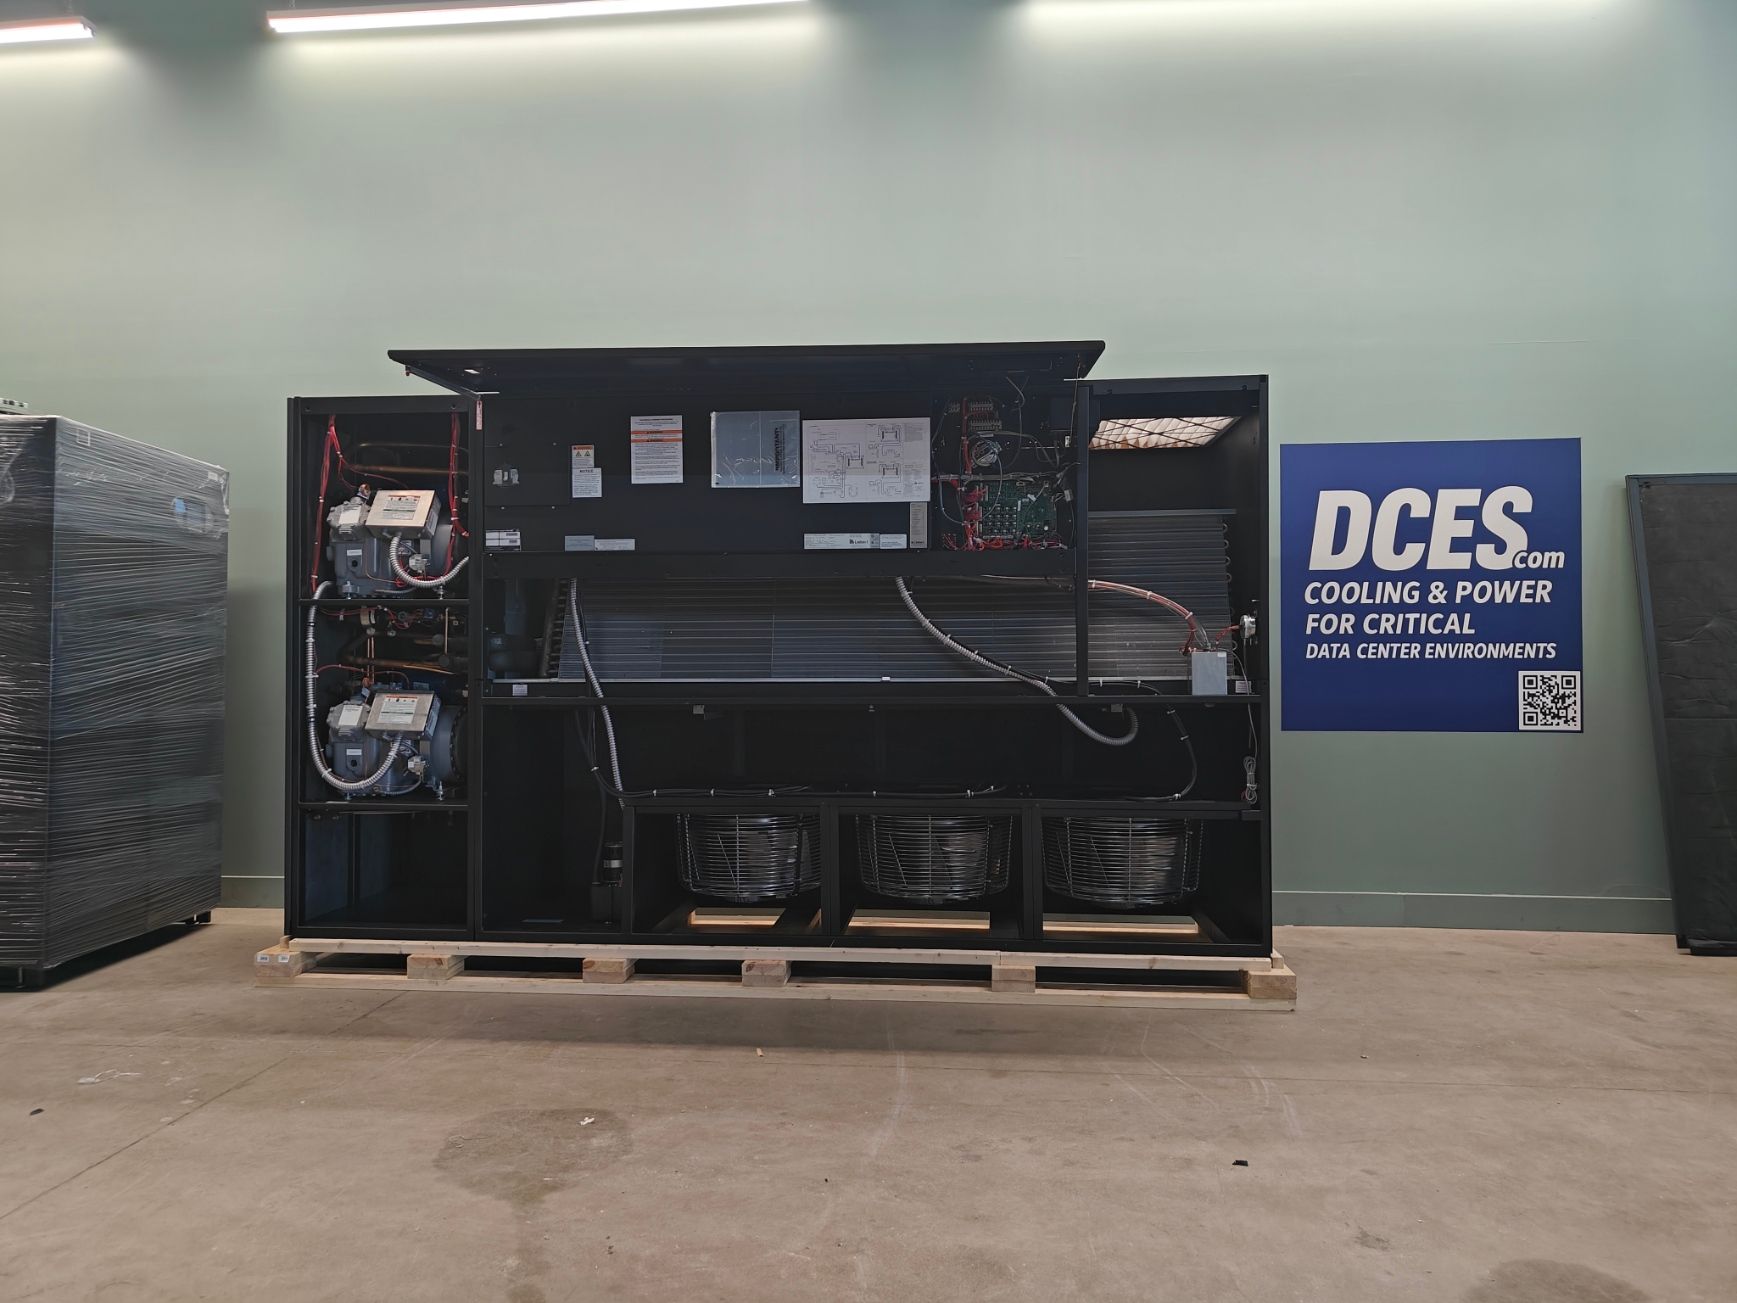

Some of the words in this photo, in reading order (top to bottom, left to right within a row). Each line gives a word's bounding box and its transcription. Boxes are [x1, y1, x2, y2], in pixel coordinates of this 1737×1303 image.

[1308, 485, 1534, 571] DCES
[1513, 551, 1565, 569] com
[1304, 581, 1421, 604] COOLING
[1427, 581, 1448, 604] &
[1455, 580, 1553, 604] POWER
[1305, 613, 1355, 635] FOR
[1362, 612, 1476, 635] CRITICAL
[1305, 643, 1351, 659] DATA
[1356, 643, 1421, 659] CENTER
[1424, 642, 1557, 659] ENVIRONMENTS
